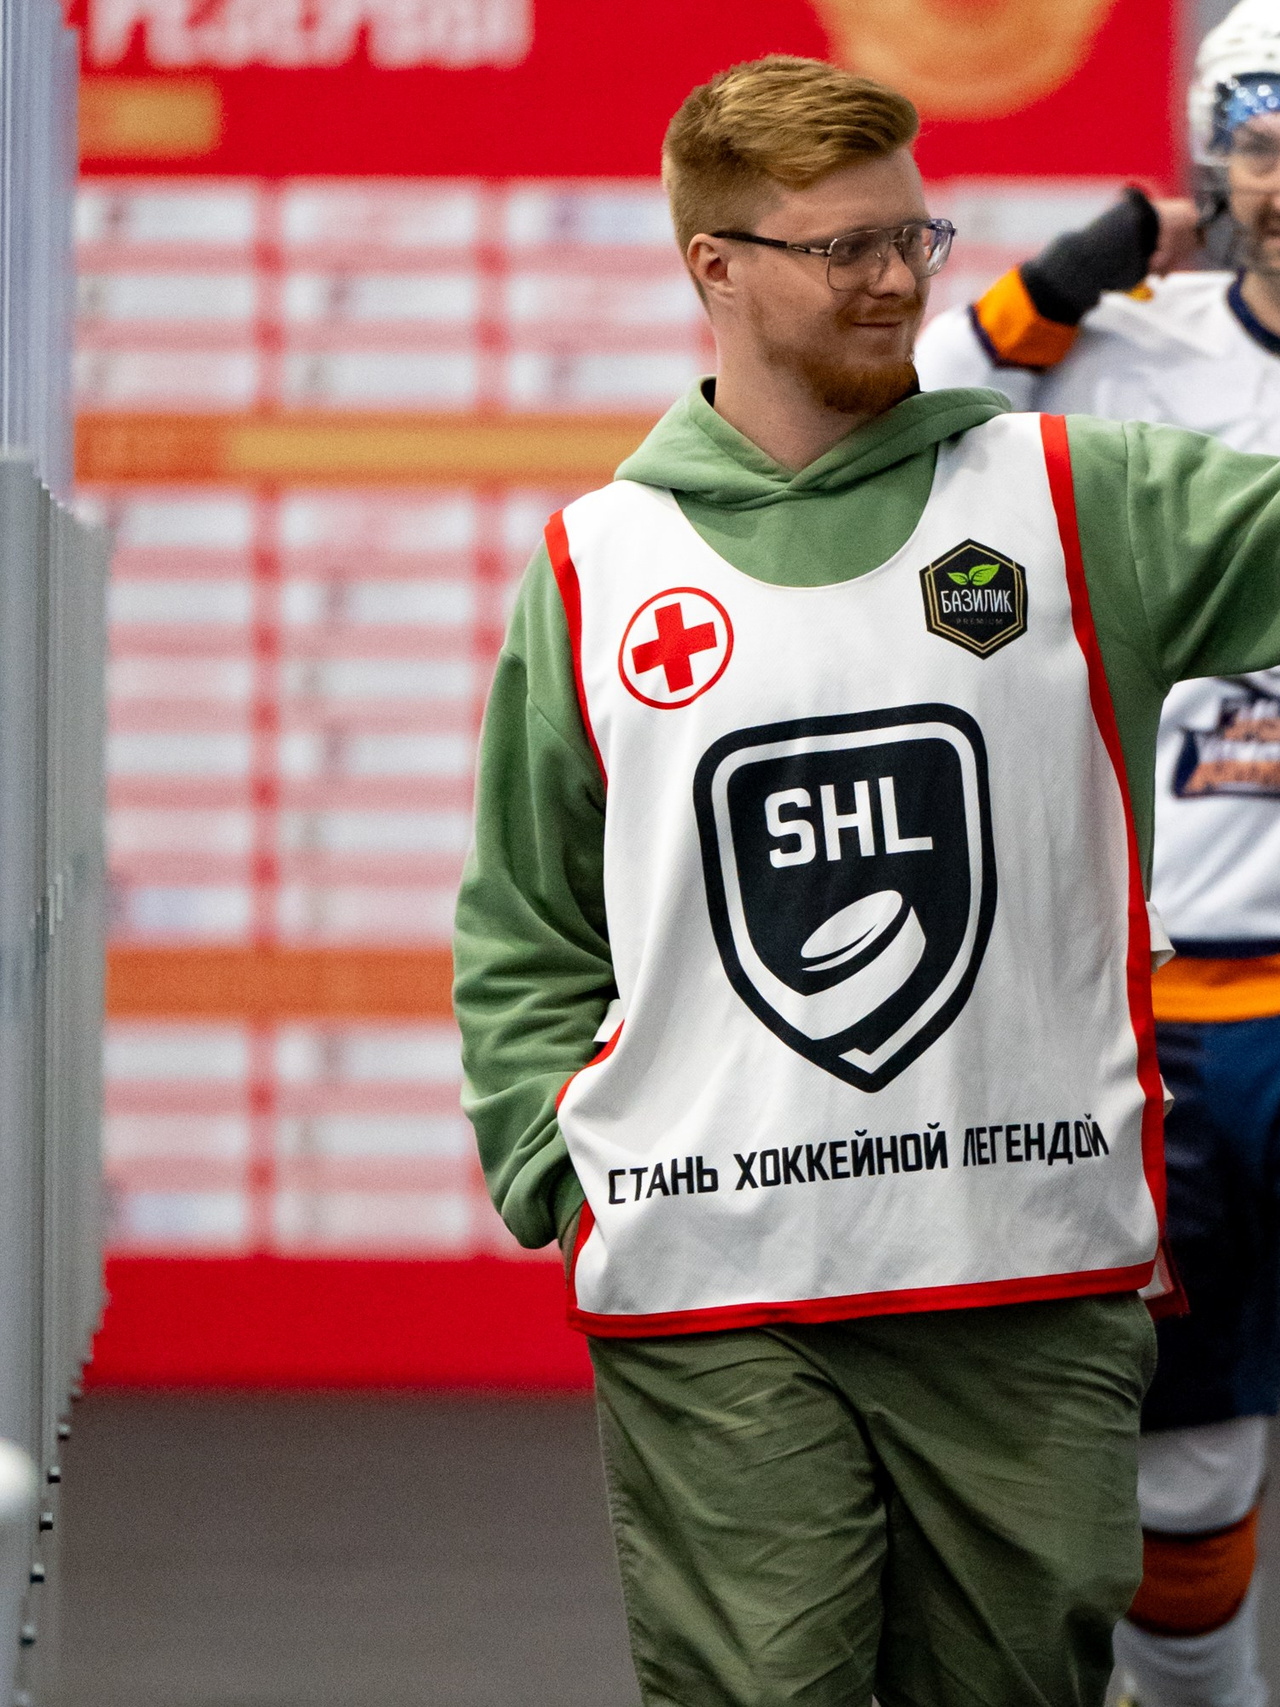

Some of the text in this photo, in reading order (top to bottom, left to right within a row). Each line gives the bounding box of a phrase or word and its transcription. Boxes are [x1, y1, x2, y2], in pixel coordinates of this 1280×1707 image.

[940, 588, 1013, 614] БАЗИЛИК
[955, 617, 1004, 625] PREMUM
[765, 776, 933, 869] SHL
[608, 1112, 1110, 1205] СТАНЬ ХОККЕЙНОЙ ЛЕГЕНДОЙ
